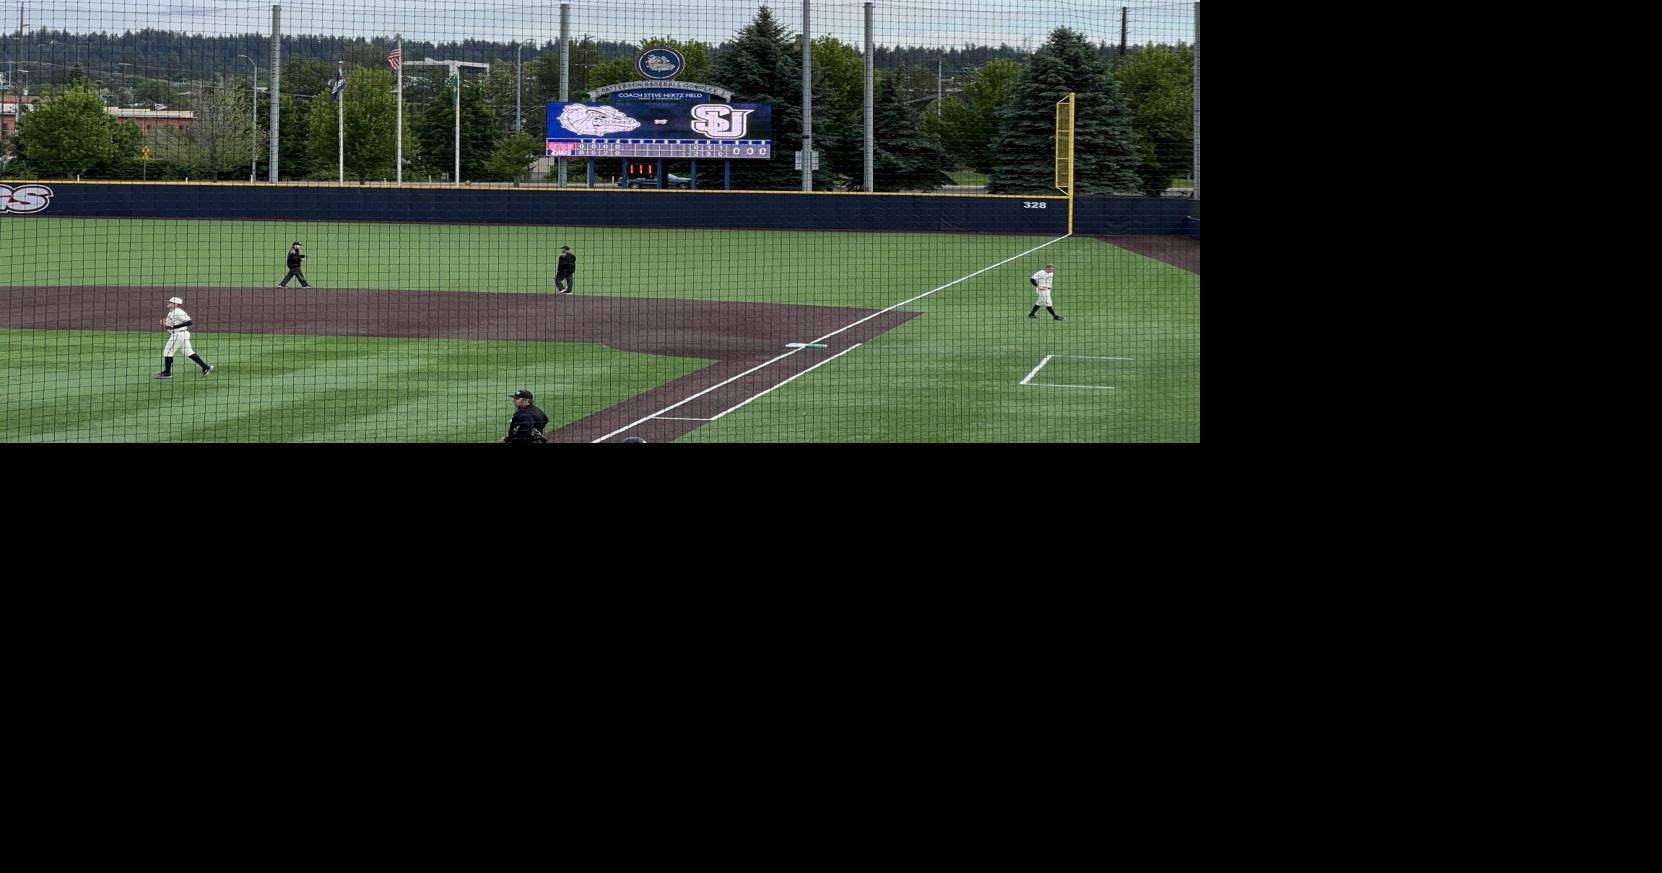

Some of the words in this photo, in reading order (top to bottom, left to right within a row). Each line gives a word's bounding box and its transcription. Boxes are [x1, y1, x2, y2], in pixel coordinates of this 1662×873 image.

[733, 147, 740, 155] 0
[746, 147, 754, 155] 0
[759, 147, 767, 155] 0
[1023, 201, 1047, 209] 328
